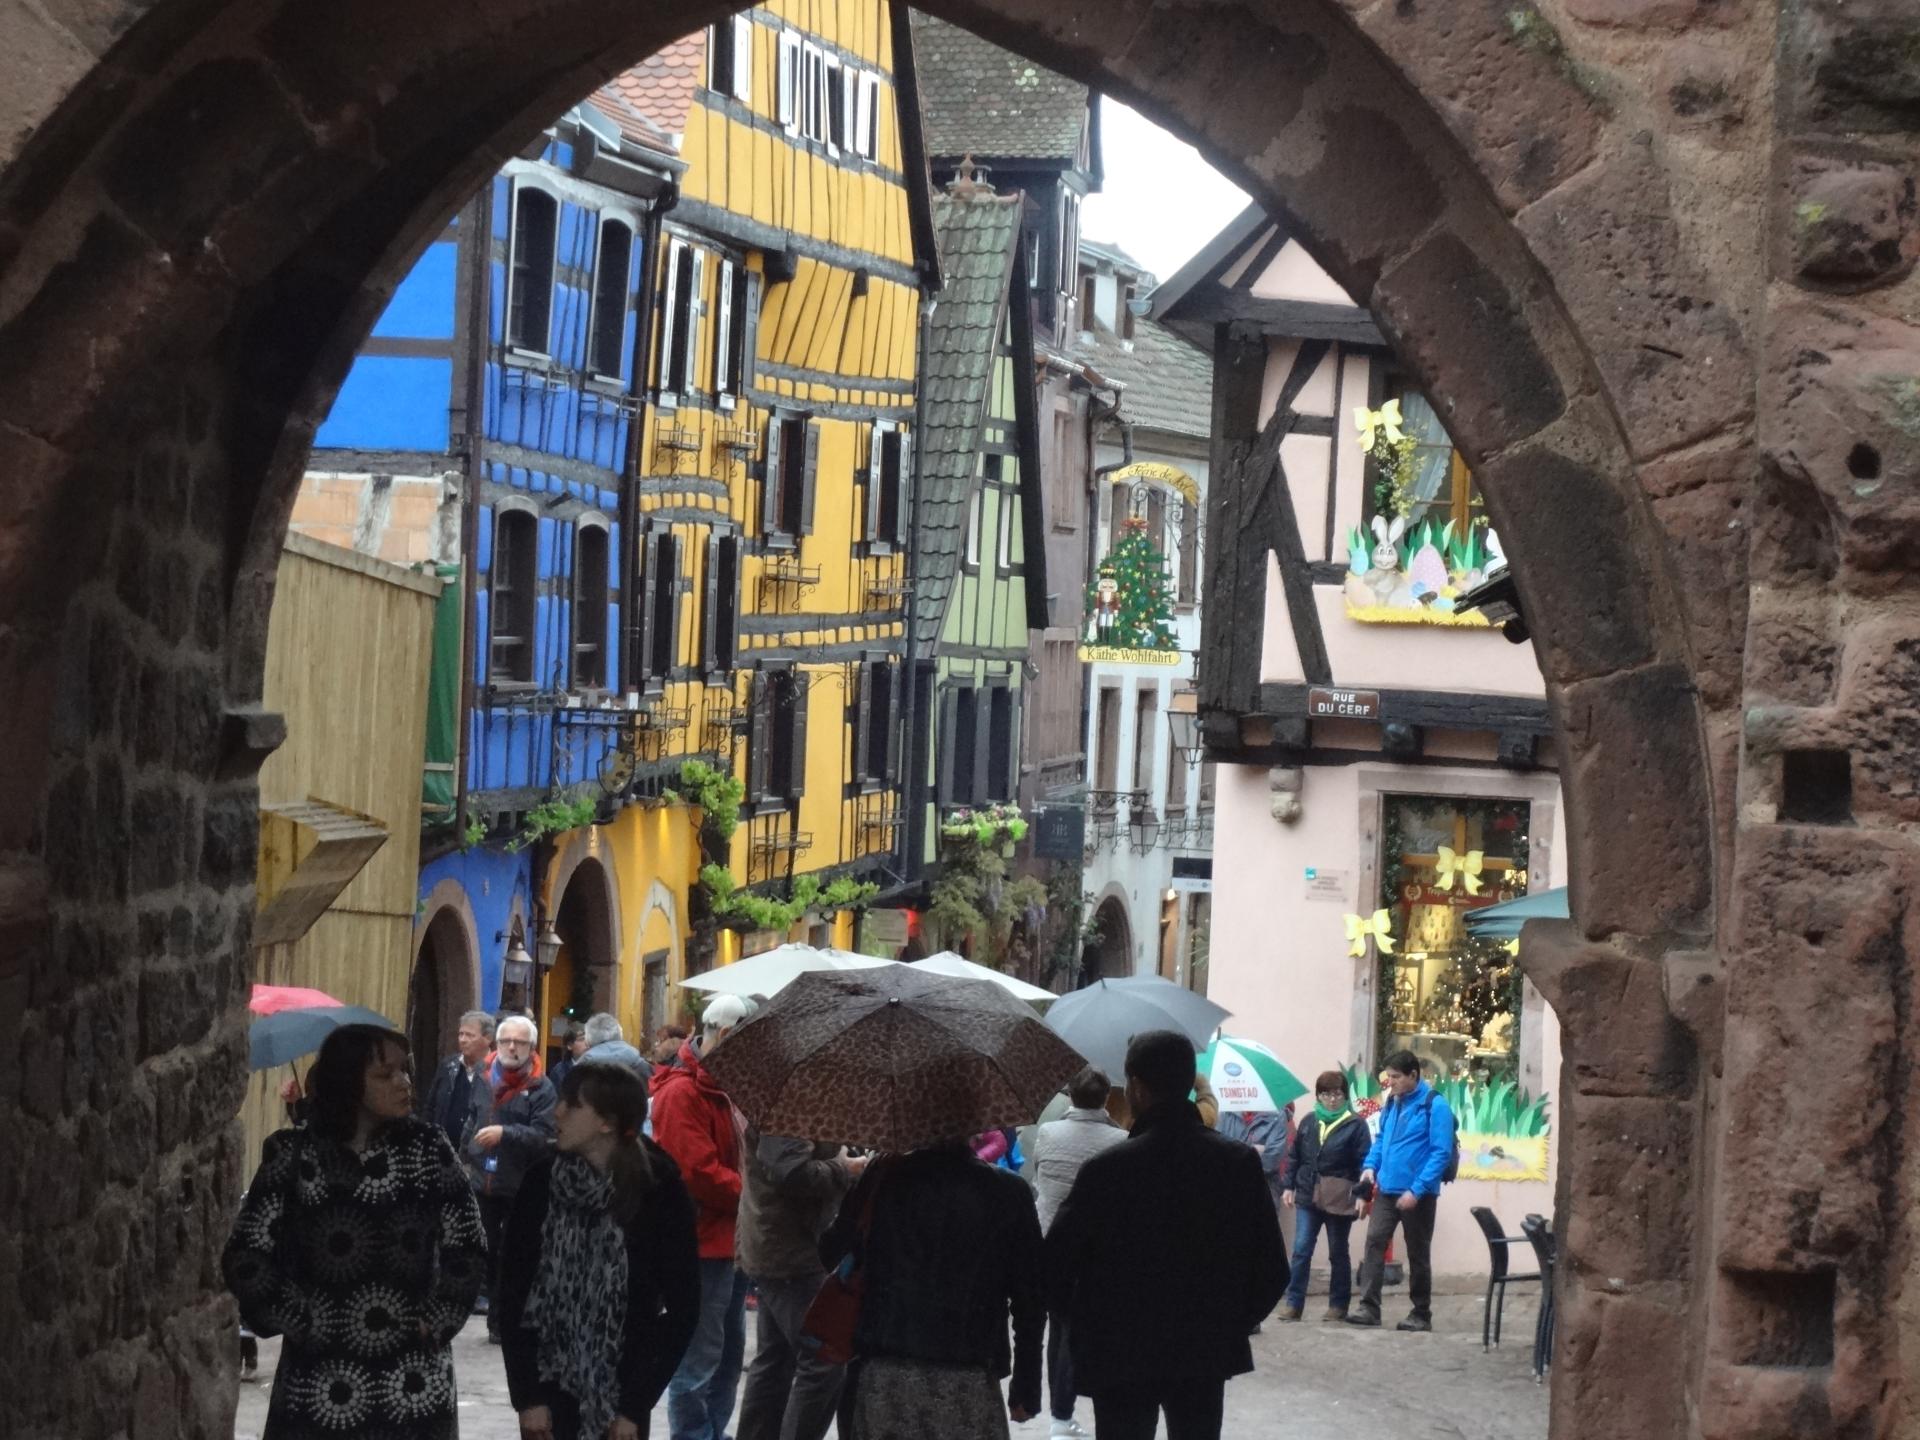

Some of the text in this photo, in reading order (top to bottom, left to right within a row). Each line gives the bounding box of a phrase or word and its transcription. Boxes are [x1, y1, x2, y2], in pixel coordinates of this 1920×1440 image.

[1160, 468, 1172, 480] de
[1087, 647, 1172, 663] Käthe Wohlfahrt
[1333, 692, 1356, 702] RUE
[1318, 702, 1371, 716] DU CERF
[1218, 1086, 1259, 1098] TSINGTAO
